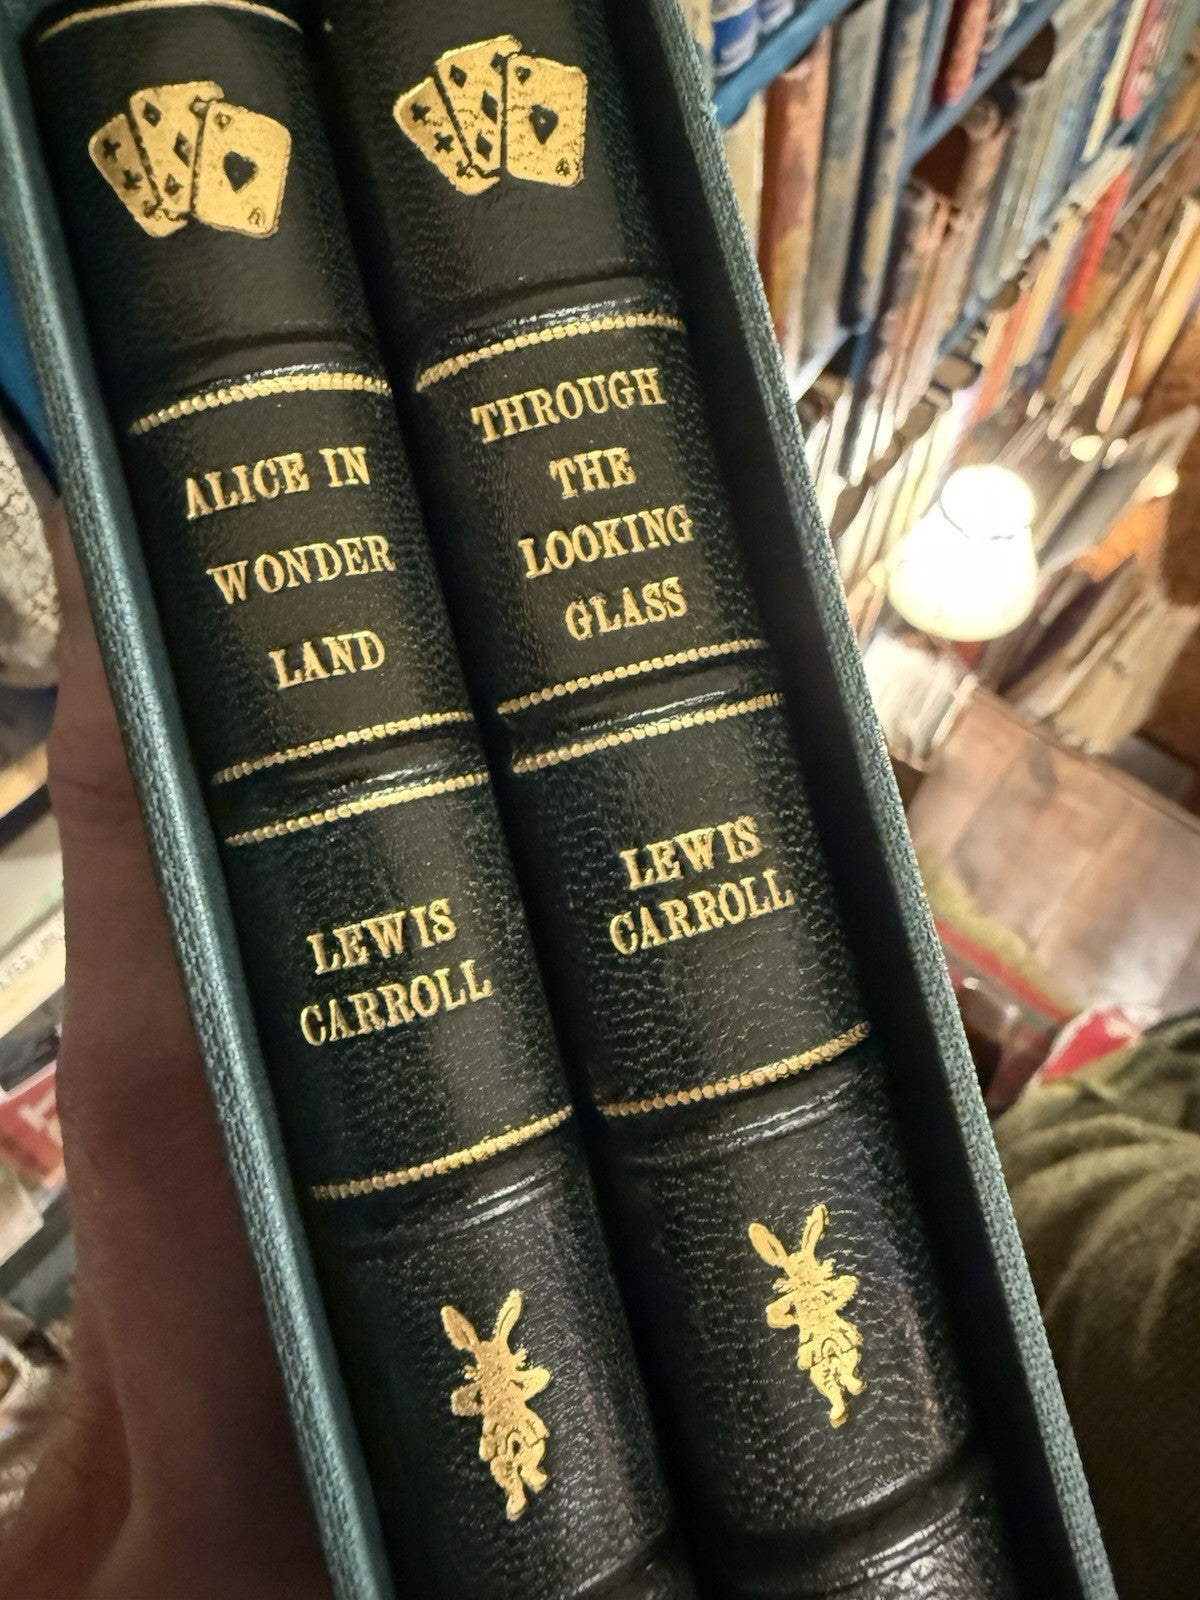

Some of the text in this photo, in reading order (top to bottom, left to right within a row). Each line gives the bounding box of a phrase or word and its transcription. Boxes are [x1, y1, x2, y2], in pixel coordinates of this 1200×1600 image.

[471, 367, 667, 444] THROUGH
[186, 446, 371, 520] ALICE IN
[550, 447, 637, 499] THE
[206, 535, 396, 604] WONDER
[517, 504, 694, 579] LOOKING
[565, 576, 688, 641] GLASS
[268, 630, 386, 690] LAND
[619, 815, 762, 890] LEWIS
[306, 898, 457, 975] LEWIS
[609, 868, 795, 955] CARROLL
[300, 959, 493, 1046] CARROLL
